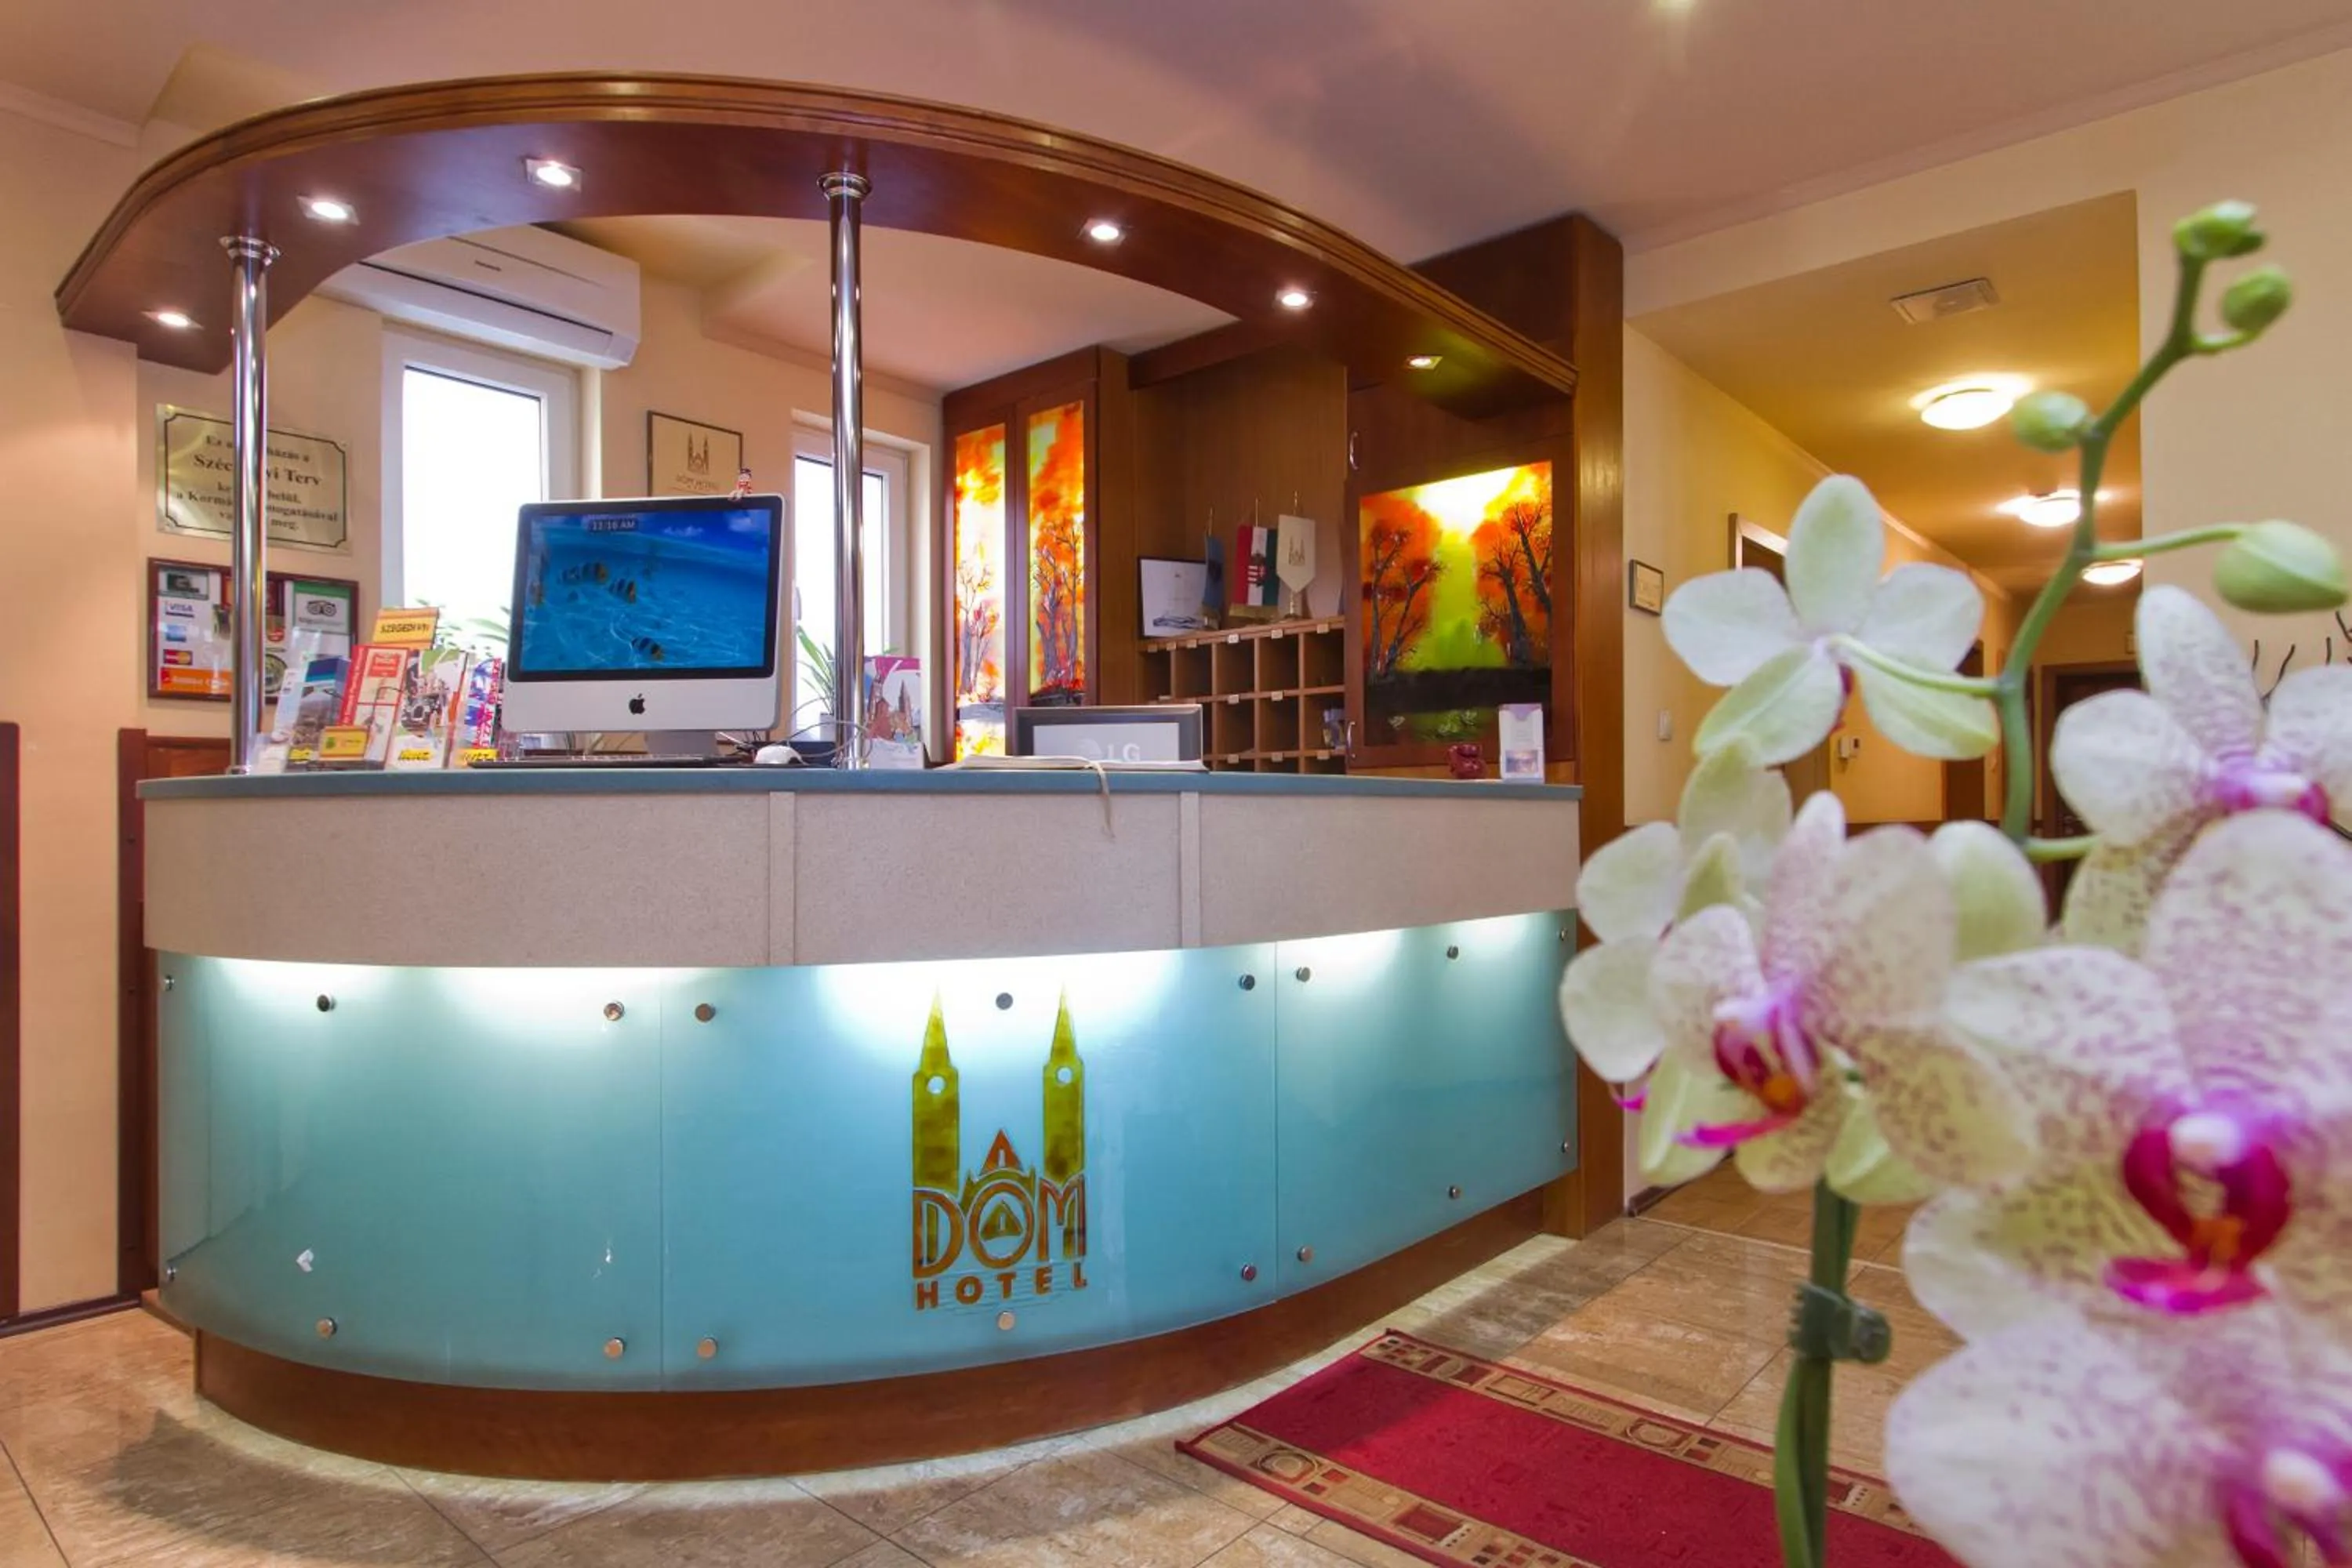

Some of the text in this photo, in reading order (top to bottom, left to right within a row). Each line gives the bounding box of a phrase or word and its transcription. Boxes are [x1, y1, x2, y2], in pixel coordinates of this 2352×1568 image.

[283, 466, 322, 485] Terv
[913, 1174, 1086, 1279] DOM
[916, 1262, 1087, 1311] HOTEL
